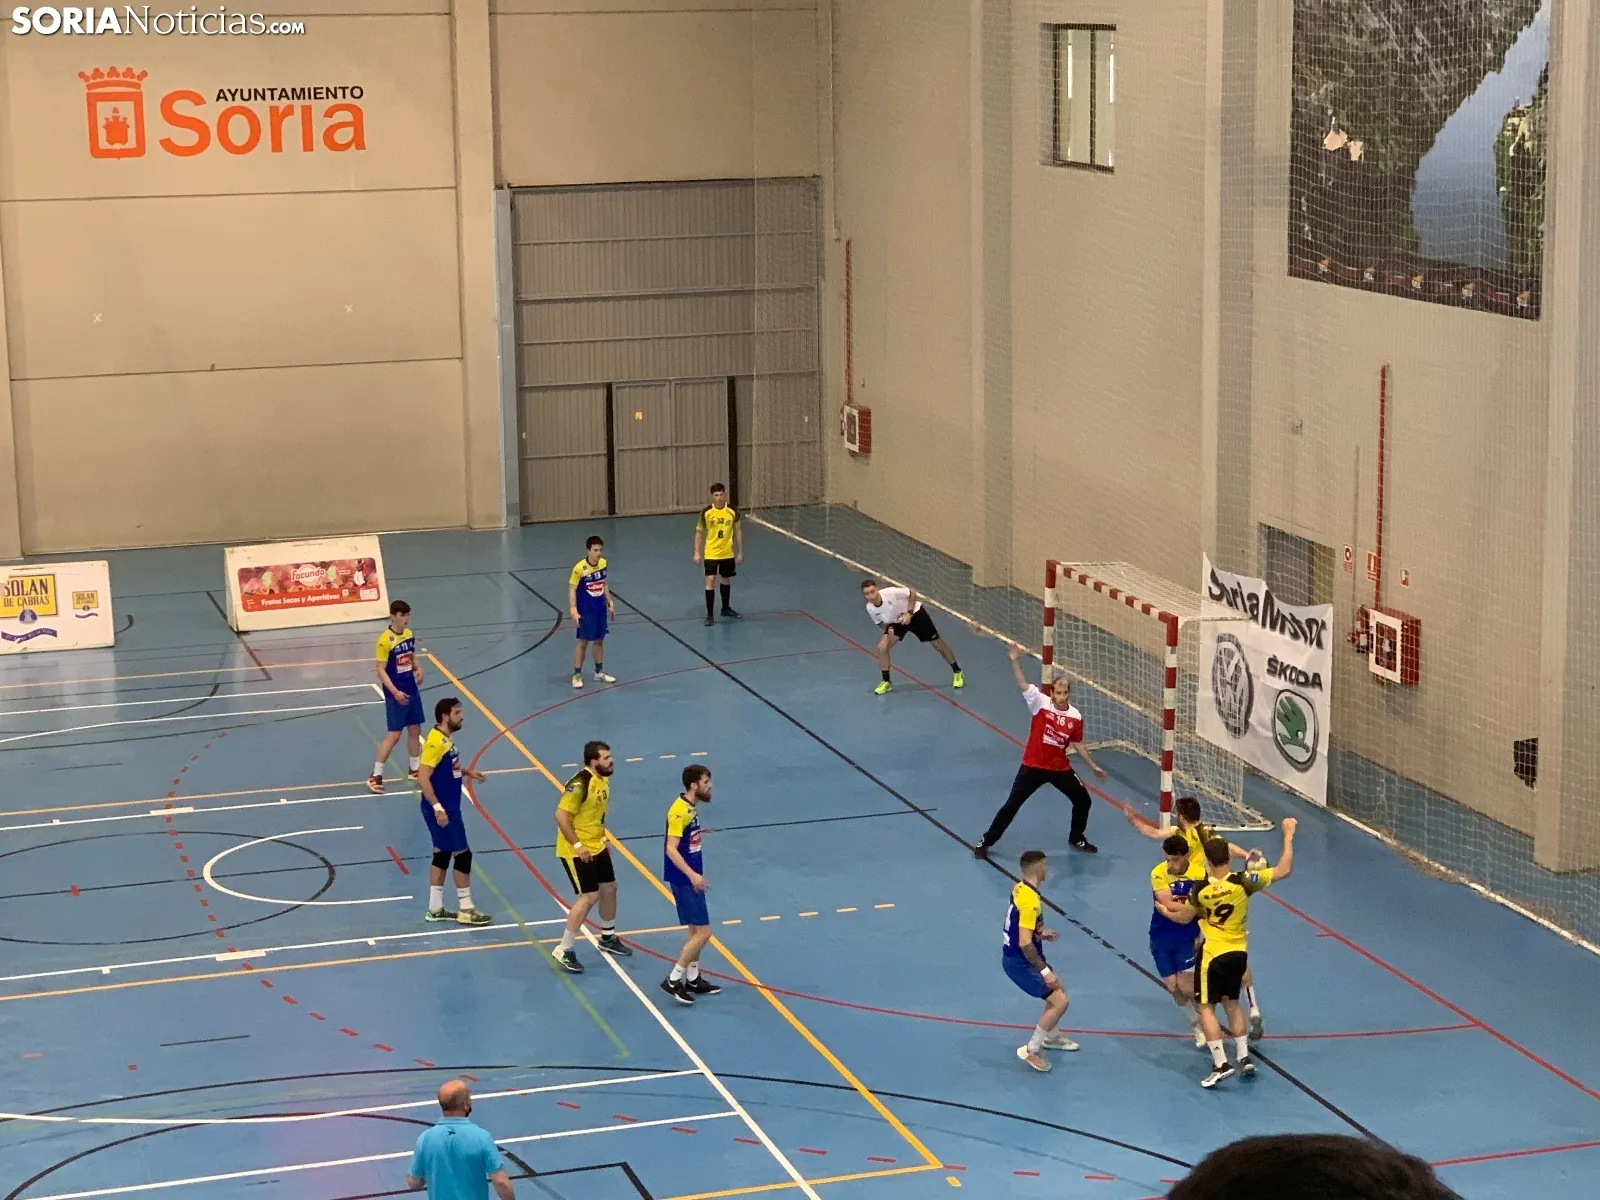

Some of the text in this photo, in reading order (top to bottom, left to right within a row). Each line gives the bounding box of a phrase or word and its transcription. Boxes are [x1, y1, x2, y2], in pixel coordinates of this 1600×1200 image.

[215, 86, 364, 102] AYUNTAMIENTO
[159, 89, 367, 157] Soria
[4, 578, 49, 597] SOLAN
[4, 595, 50, 607] DE CABRAS
[1056, 715, 1065, 727] 16
